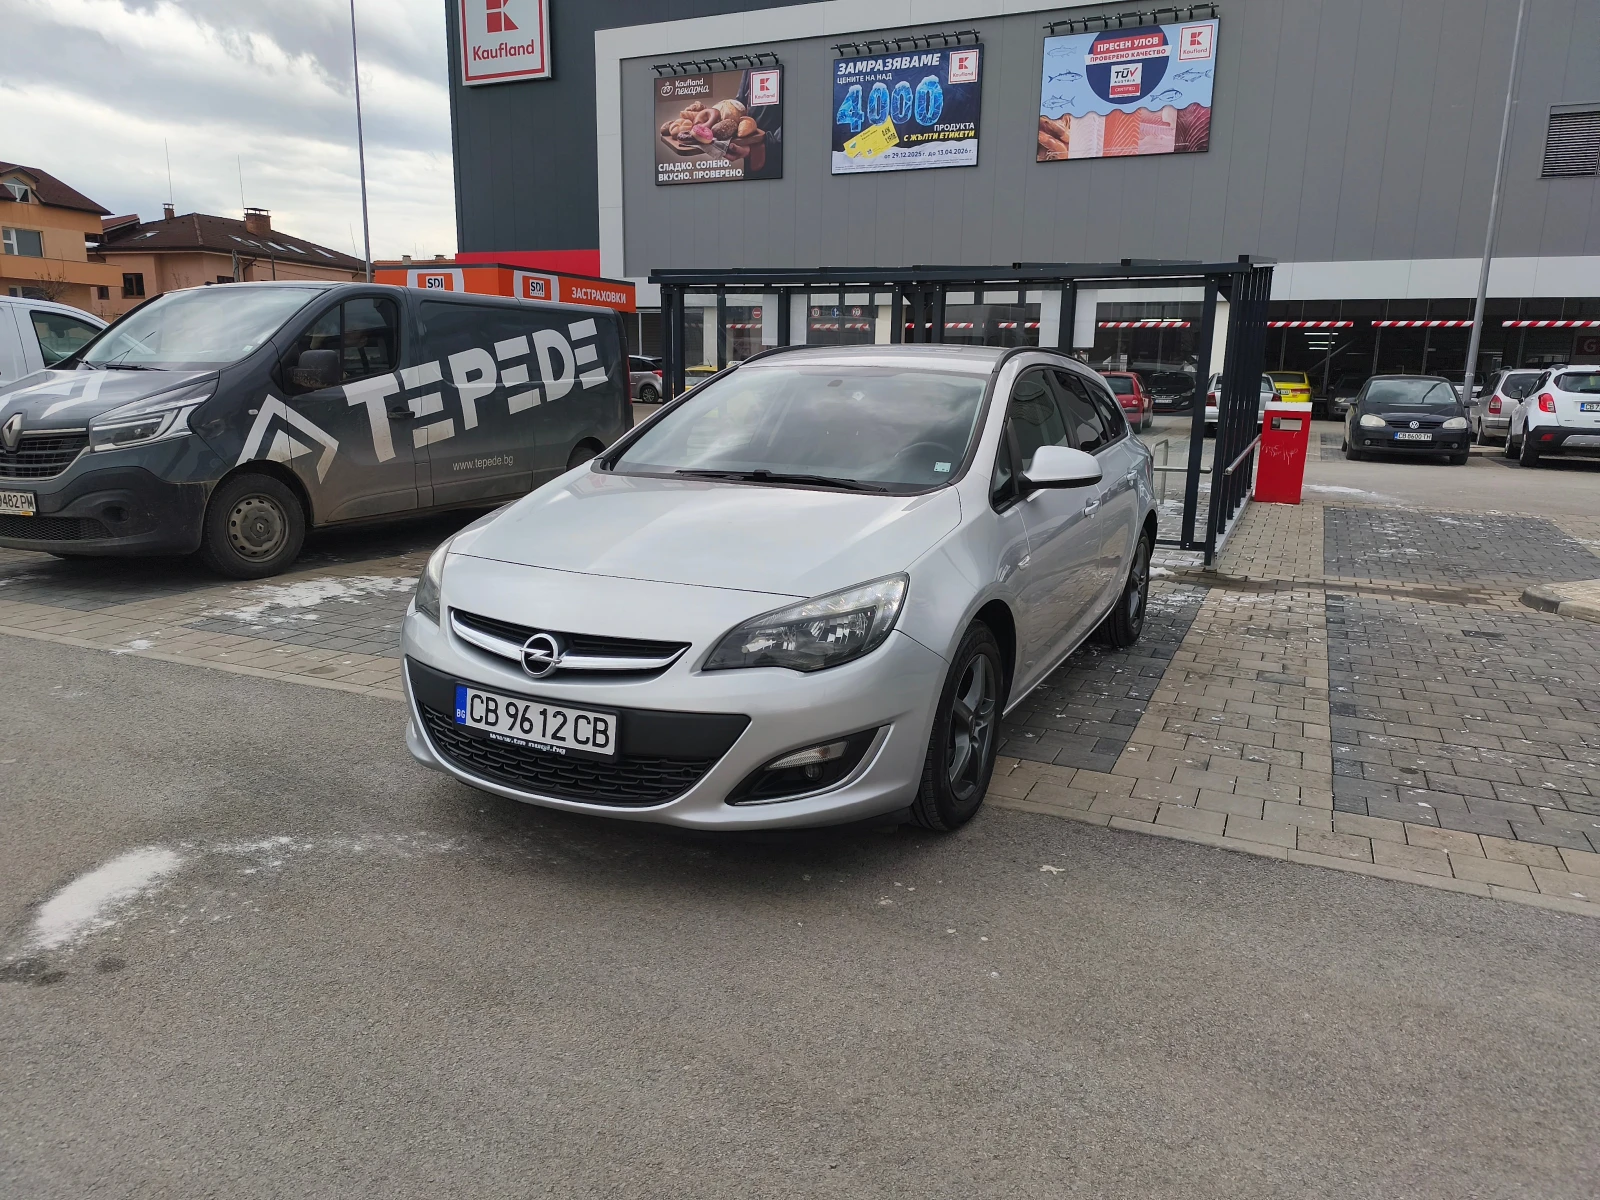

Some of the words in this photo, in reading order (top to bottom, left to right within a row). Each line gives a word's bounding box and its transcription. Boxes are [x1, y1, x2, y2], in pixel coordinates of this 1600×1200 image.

[473, 39, 534, 61] Kaufland
[1097, 39, 1131, 52] ПРЕСЕН
[1133, 37, 1159, 47] УЛОВ
[1090, 53, 1129, 63] ПРОВЕРЕНО
[1131, 49, 1166, 59] КАЧЕСТВО
[1183, 47, 1207, 55] Kaufland
[837, 53, 941, 75] ЗАМРАЗЯВАМЕ
[837, 76, 864, 84] ЦЕНИТЕ
[876, 73, 892, 81] НАД
[1115, 67, 1138, 79] TÜV
[675, 78, 704, 87] Kaufland
[675, 84, 709, 96] пекарна
[837, 75, 943, 132] 4000
[934, 122, 975, 132] ПРОДУКТА
[910, 132, 938, 141] ЖЪЛТИ
[939, 130, 975, 139] ЕТИКЕТИ
[892, 151, 921, 159] 29.12.2025
[937, 148, 968, 156] 13.04.2026
[658, 162, 694, 172] СЛАДКО.
[696, 159, 731, 169] СОЛЕНО.
[658, 172, 691, 182] ВКУСНО.
[693, 168, 744, 179] ПРОВЕРЕНО.
[427, 278, 443, 289] SDI
[531, 281, 544, 293] SDI
[571, 287, 626, 304] ЗАСТРАХОВКИ
[342, 318, 608, 462] TEPEDE
[453, 454, 514, 471] www.tepede.bg
[456, 708, 466, 719] BG
[470, 694, 499, 727] CB
[505, 701, 567, 742] 9612
[574, 714, 610, 748] CB
